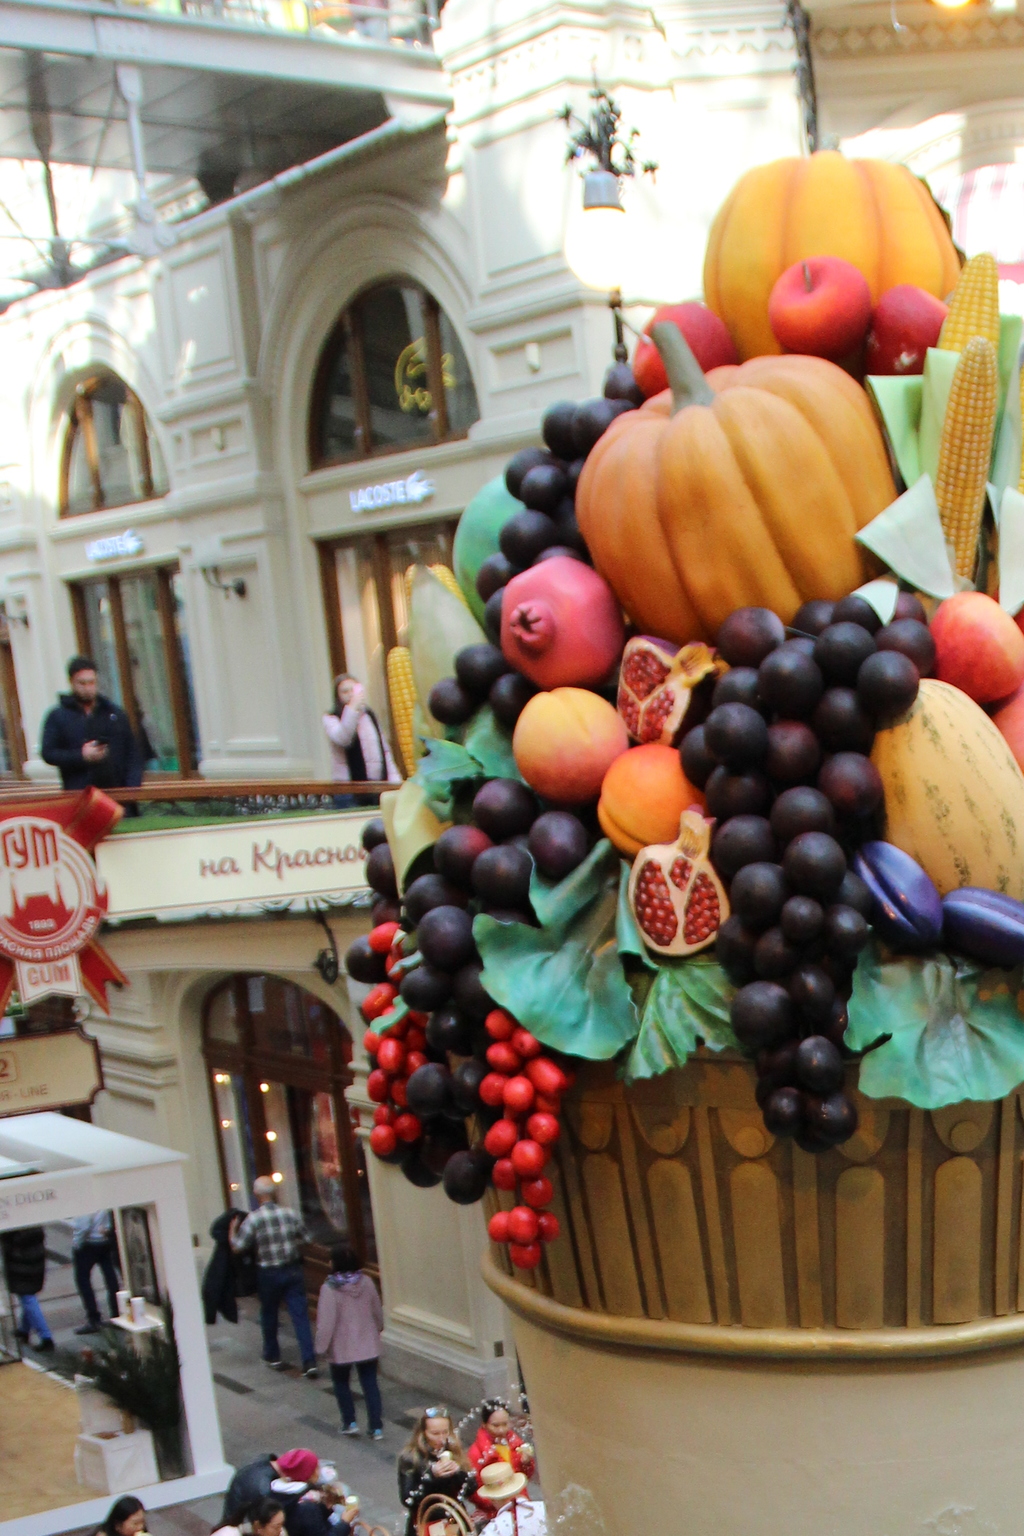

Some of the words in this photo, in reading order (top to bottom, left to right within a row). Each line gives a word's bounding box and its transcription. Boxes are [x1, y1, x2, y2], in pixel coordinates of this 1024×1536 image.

[349, 480, 406, 513] LACOSTE
[3, 824, 59, 868] ГУМ
[200, 856, 241, 877] на
[27, 964, 72, 988] GUM
[15, 1188, 57, 1207] DIOR
